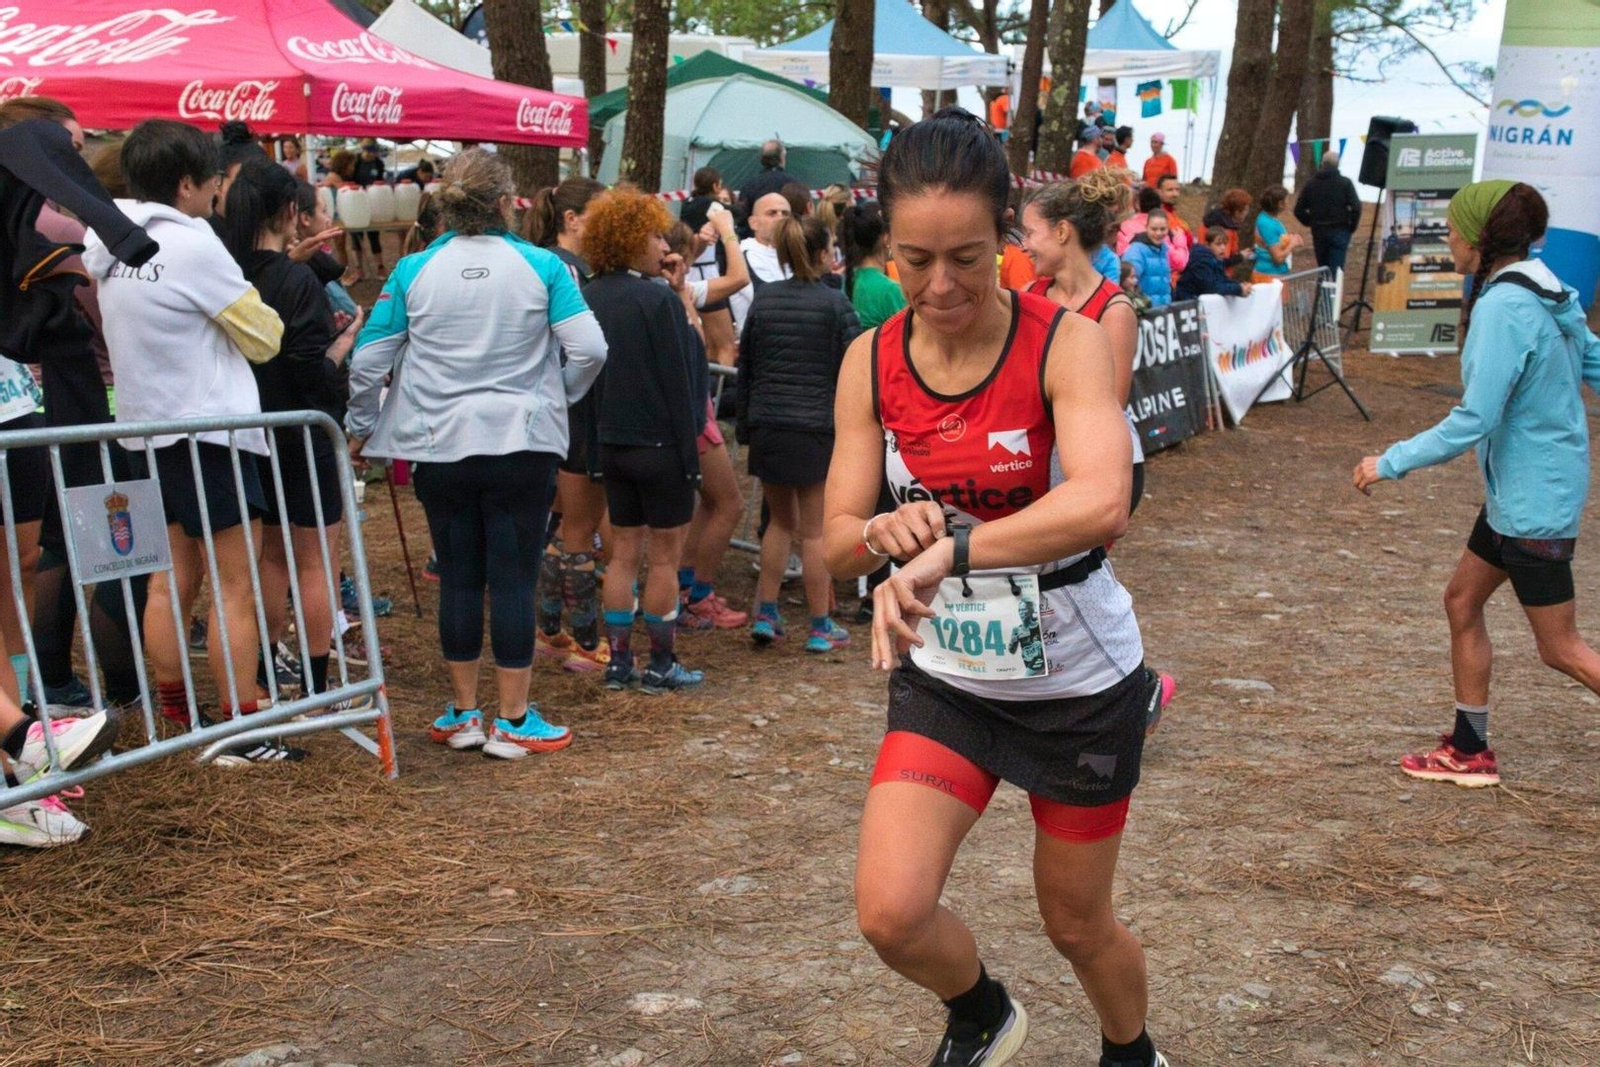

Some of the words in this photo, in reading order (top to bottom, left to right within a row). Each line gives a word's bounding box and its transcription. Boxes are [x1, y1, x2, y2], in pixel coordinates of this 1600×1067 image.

[1489, 123, 1573, 146] NIGRÁN
[1424, 157, 1474, 167] Balance
[1425, 146, 1465, 157] Active
[1126, 386, 1187, 424] ALPINE
[990, 459, 1033, 473] vértice
[889, 477, 1034, 509] vértice
[94, 560, 126, 574] CONCELLO
[135, 553, 159, 566] NIGRÁN
[930, 616, 1006, 656] 1284
[900, 769, 956, 794] SURAL
